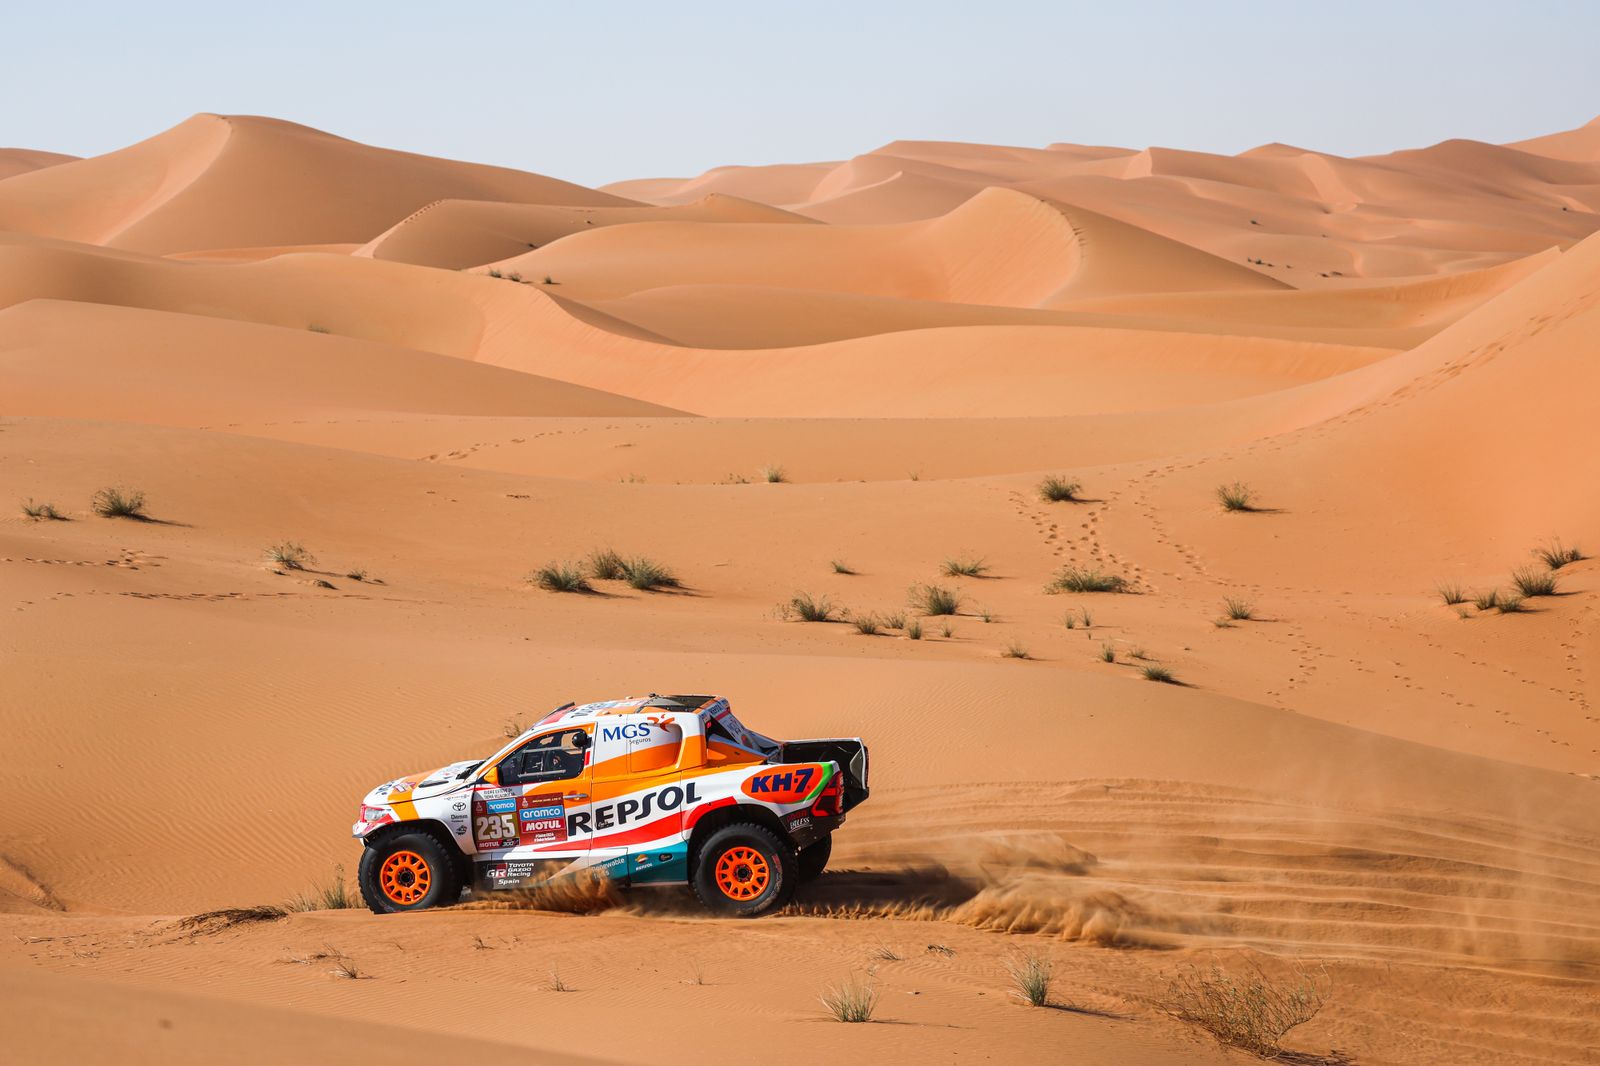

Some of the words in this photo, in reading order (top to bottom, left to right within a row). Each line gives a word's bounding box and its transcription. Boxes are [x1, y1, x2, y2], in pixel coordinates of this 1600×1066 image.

[603, 722, 651, 742] MGS
[629, 737, 651, 745] Seguros
[751, 768, 814, 793] KH-7
[488, 801, 515, 810] aramco
[567, 782, 702, 836] REPSOL
[522, 808, 561, 819] aramco
[476, 814, 516, 840] 235
[525, 820, 561, 831] MOTUL
[486, 869, 507, 878] GR
